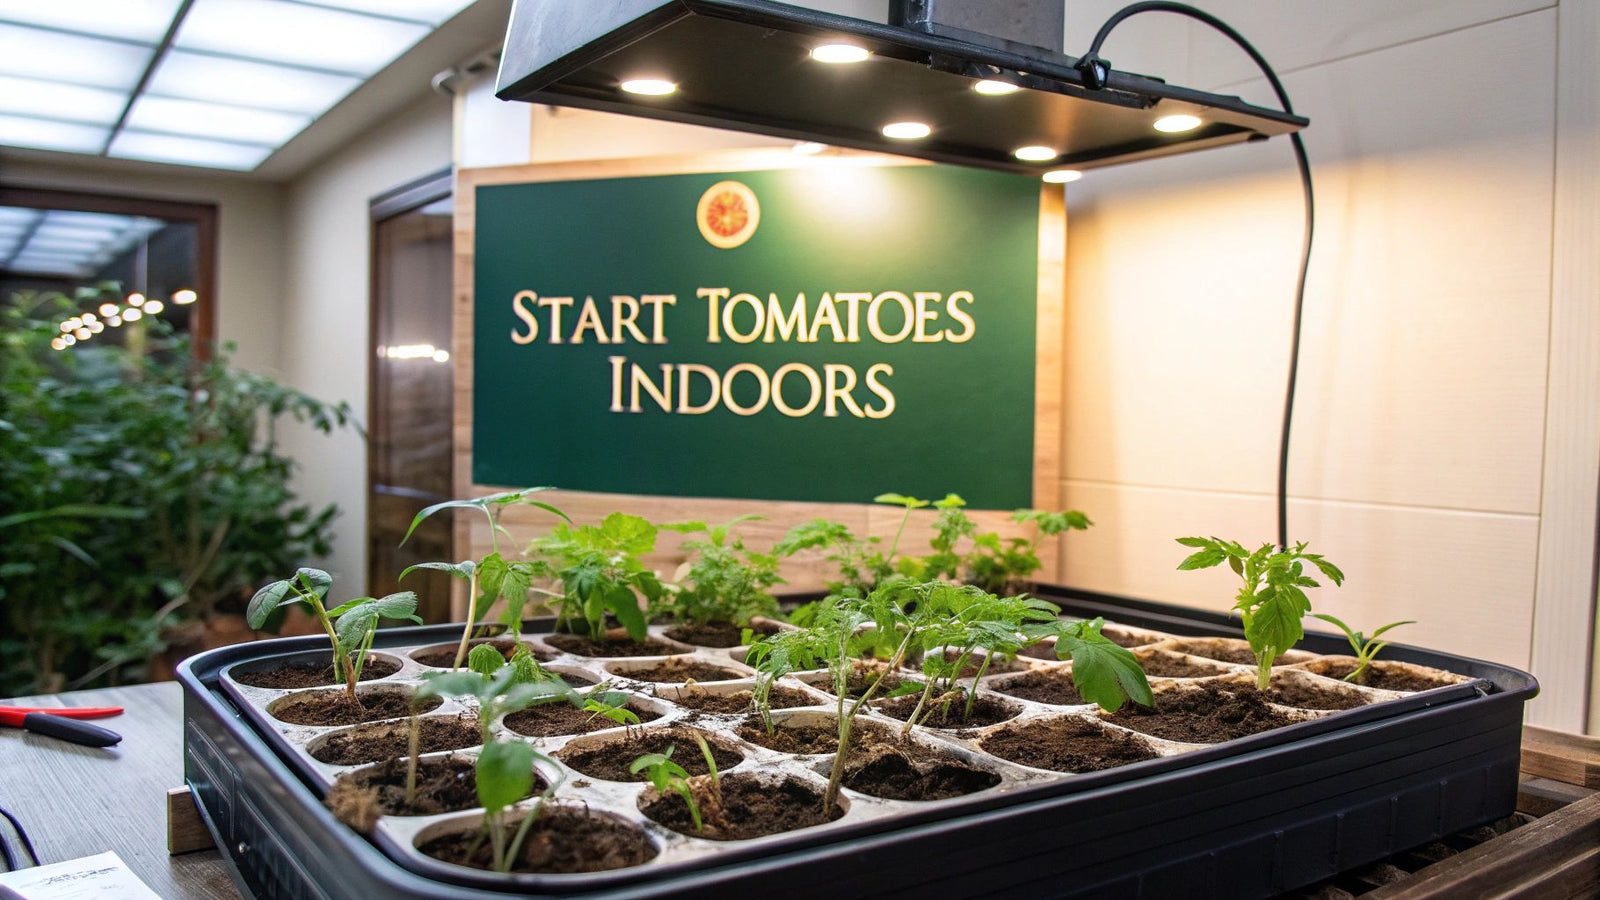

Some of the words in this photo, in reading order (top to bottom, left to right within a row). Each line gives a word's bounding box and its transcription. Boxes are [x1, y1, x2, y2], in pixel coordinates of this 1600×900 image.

[511, 290, 677, 344] START
[696, 287, 976, 343] TOMATOES
[608, 356, 896, 418] INDOORS
